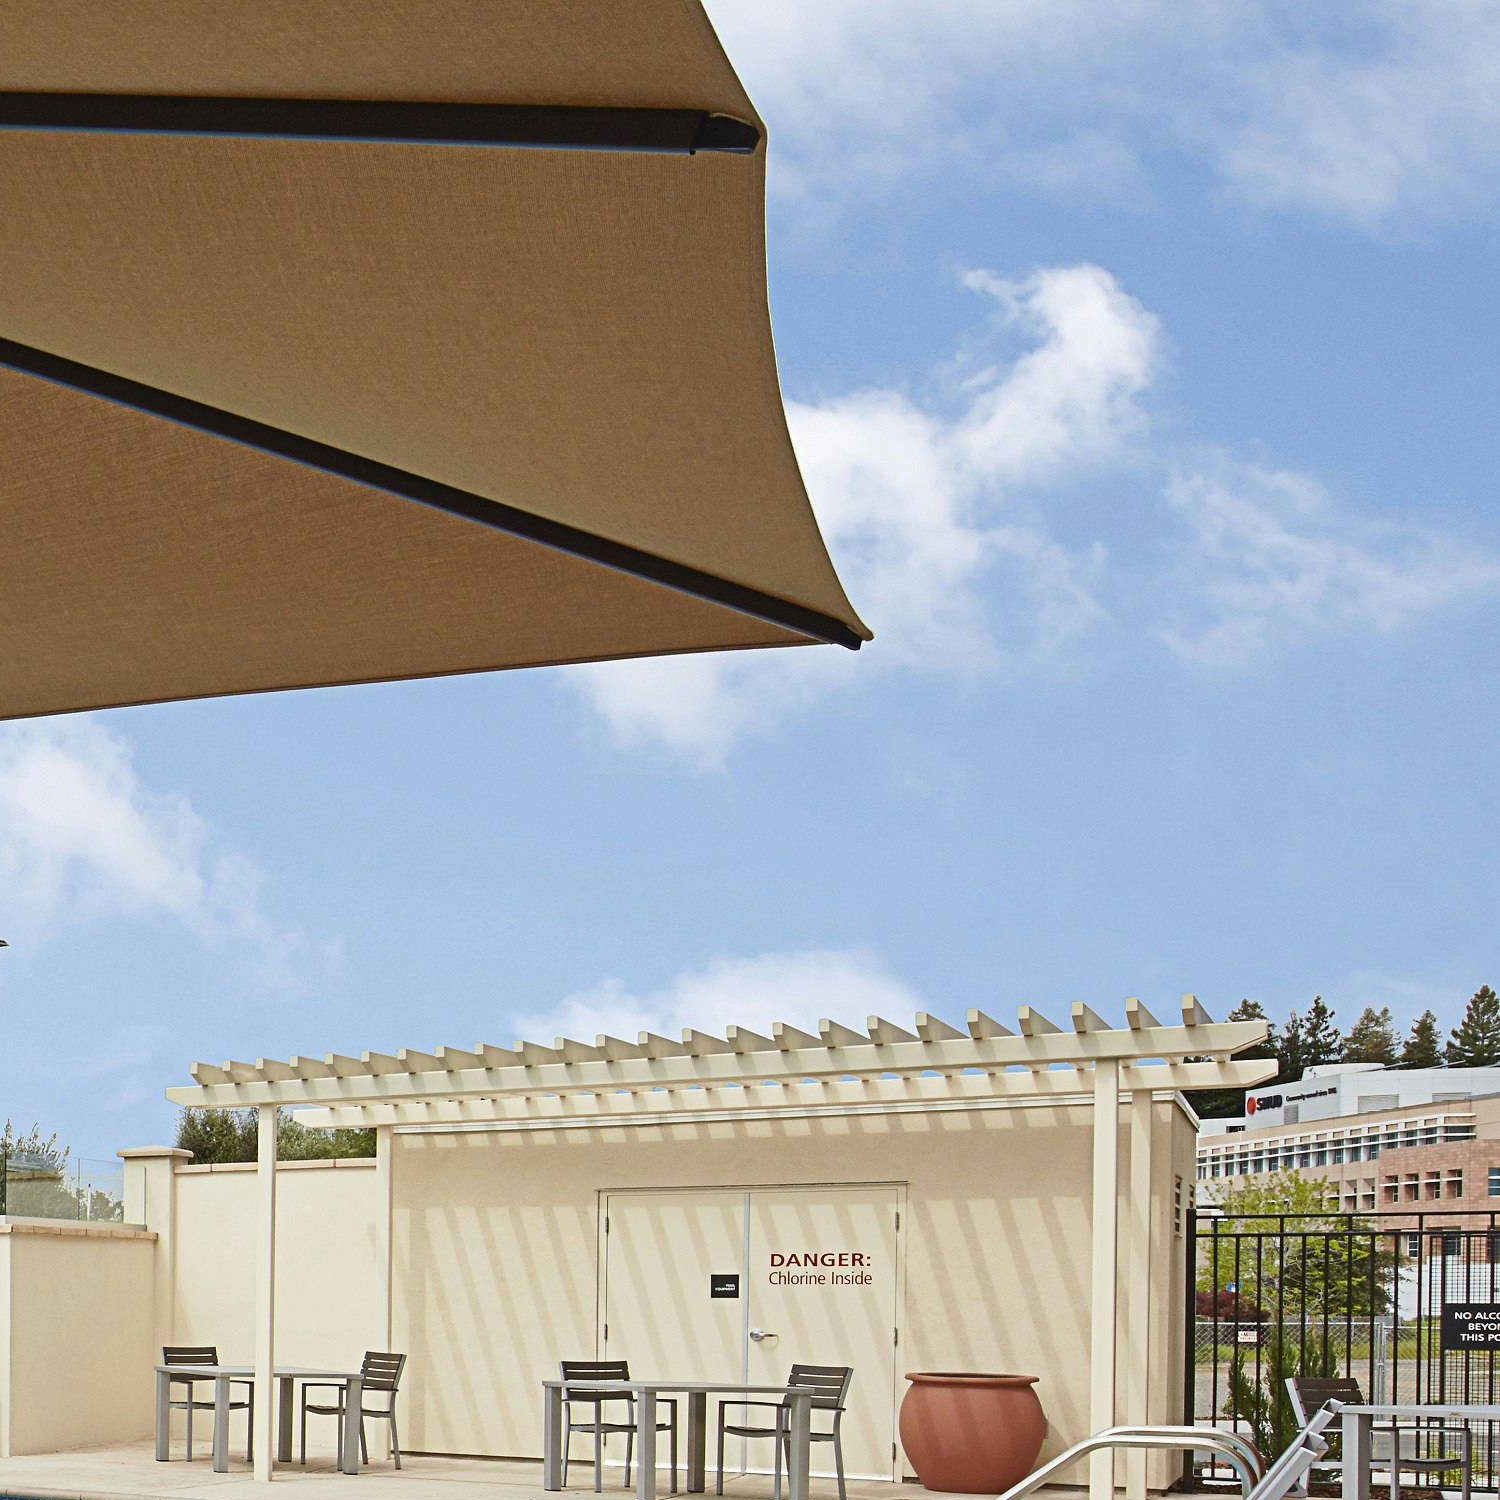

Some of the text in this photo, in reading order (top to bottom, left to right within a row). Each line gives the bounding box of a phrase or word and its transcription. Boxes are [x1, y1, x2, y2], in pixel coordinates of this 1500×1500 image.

[771, 1253, 871, 1267] DANGER:
[769, 1270, 872, 1285] Chlorine Inside
[1454, 1311, 1472, 1320] NO
[1460, 1333, 1485, 1342] THIS
